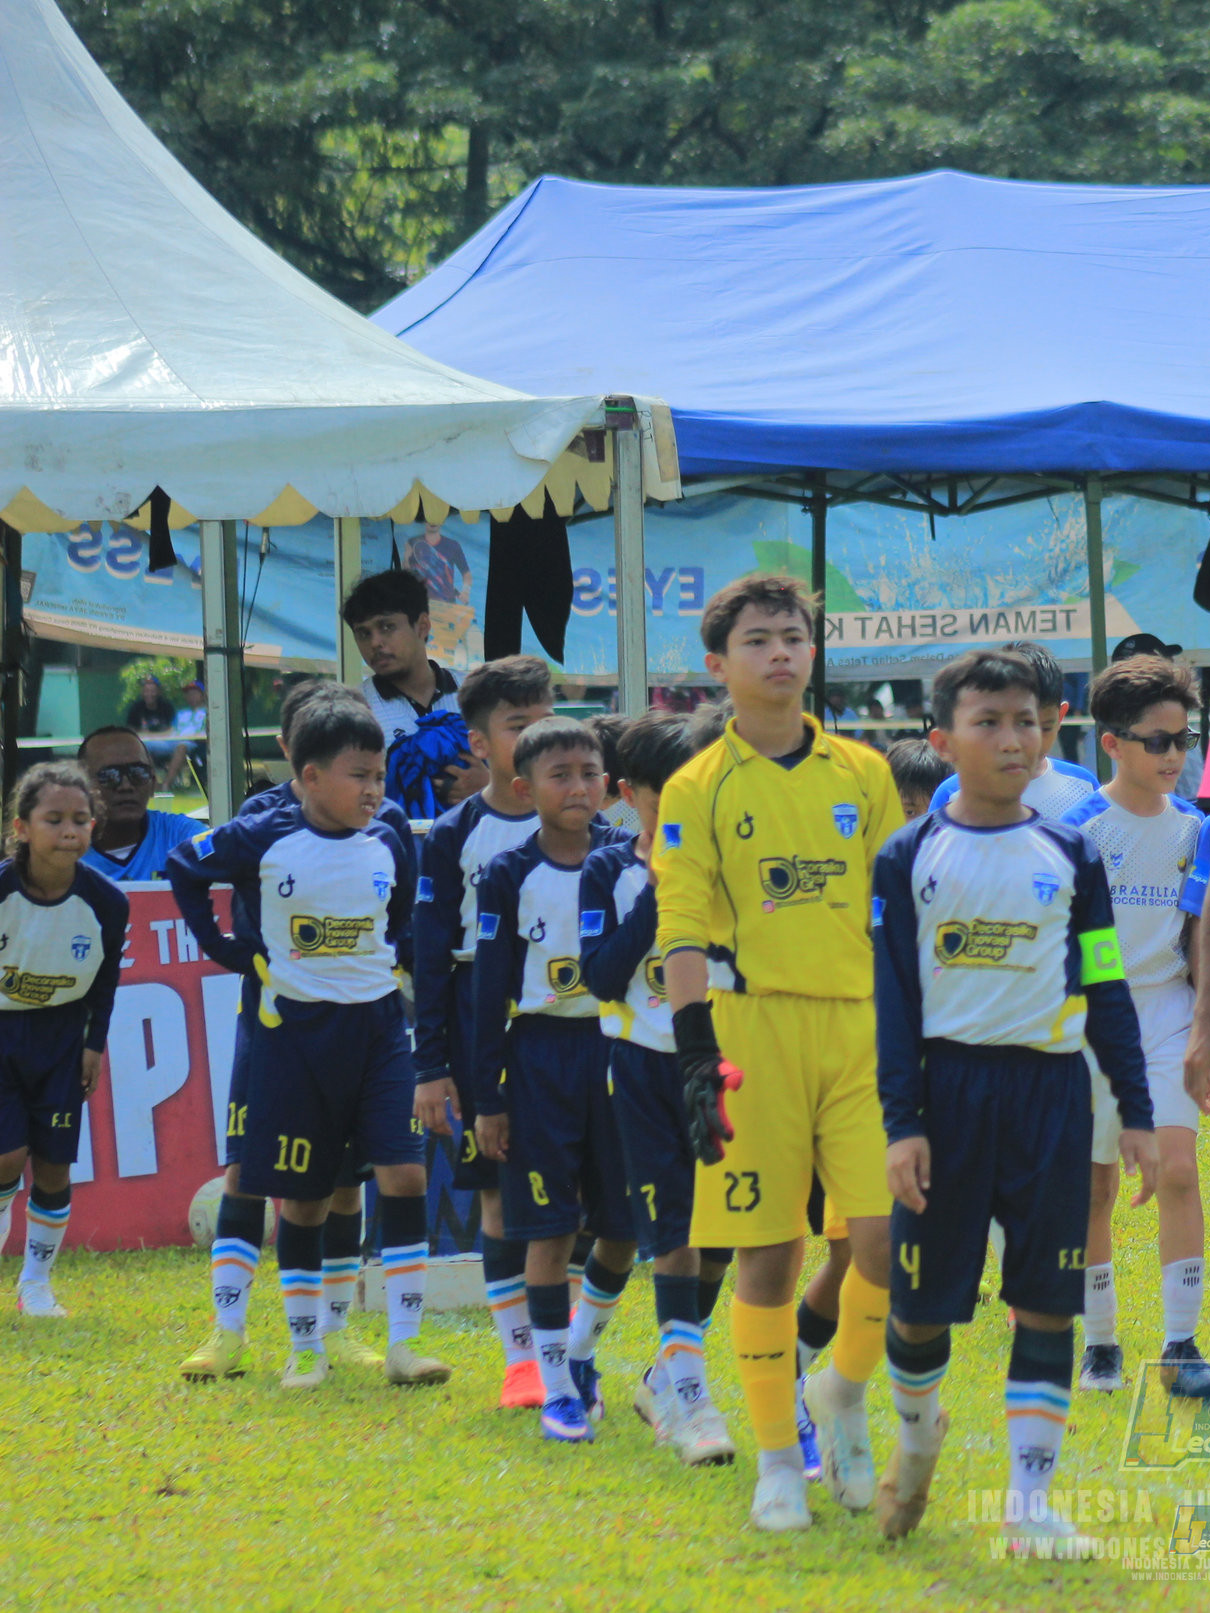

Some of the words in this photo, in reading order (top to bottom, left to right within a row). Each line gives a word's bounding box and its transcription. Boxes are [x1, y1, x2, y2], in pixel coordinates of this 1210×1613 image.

[1110, 884, 1178, 898] BRAZILIA
[1093, 941, 1118, 970] C
[274, 1135, 311, 1173] 10
[528, 1171, 549, 1206] 8
[724, 1171, 761, 1212] 23
[900, 1243, 920, 1289] 4
